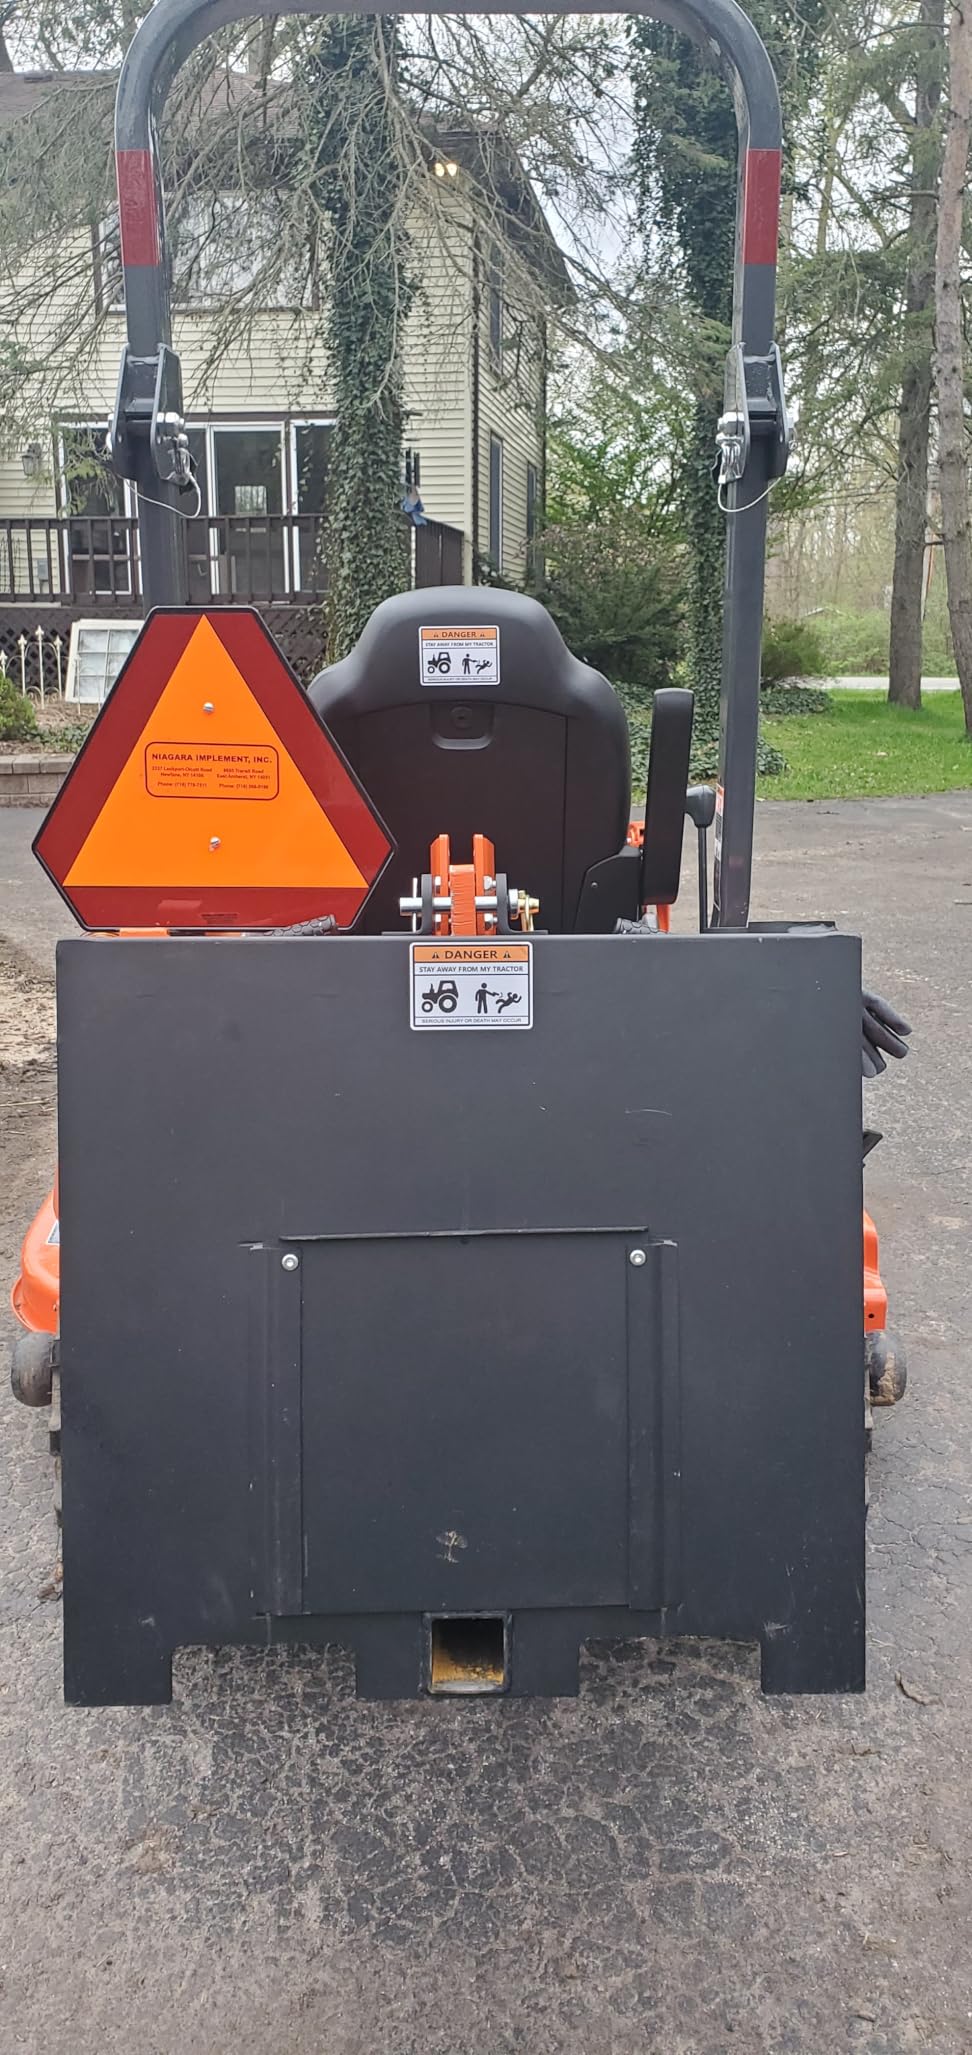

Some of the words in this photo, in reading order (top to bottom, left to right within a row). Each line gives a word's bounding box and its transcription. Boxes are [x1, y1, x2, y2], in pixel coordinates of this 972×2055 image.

[152, 753, 193, 761] NIAGARA
[196, 754, 251, 764] IMPLEMENT,
[444, 950, 498, 959] DANGER
